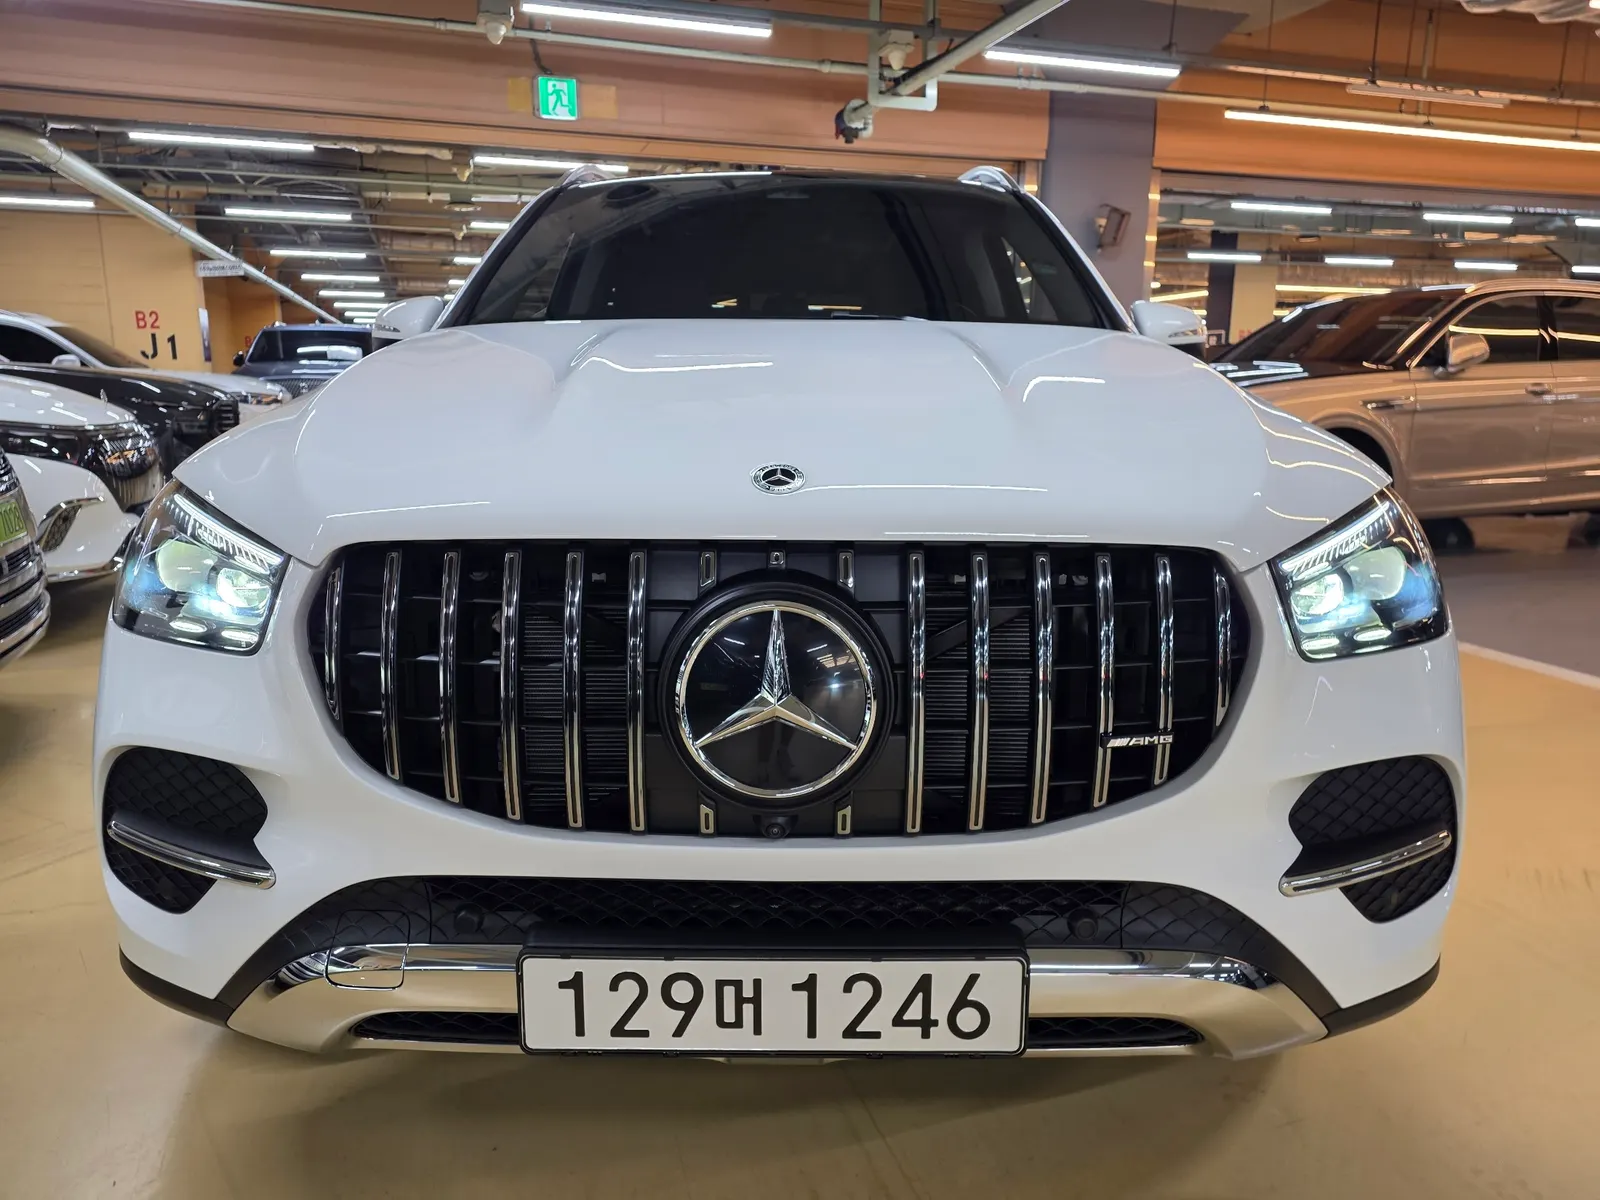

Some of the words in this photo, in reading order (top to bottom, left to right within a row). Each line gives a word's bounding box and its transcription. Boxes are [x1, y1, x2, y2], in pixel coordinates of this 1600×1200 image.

[135, 311, 160, 330] B2
[1128, 734, 1173, 746] AMG
[557, 970, 763, 1039] 129머
[791, 973, 991, 1040] 1246
